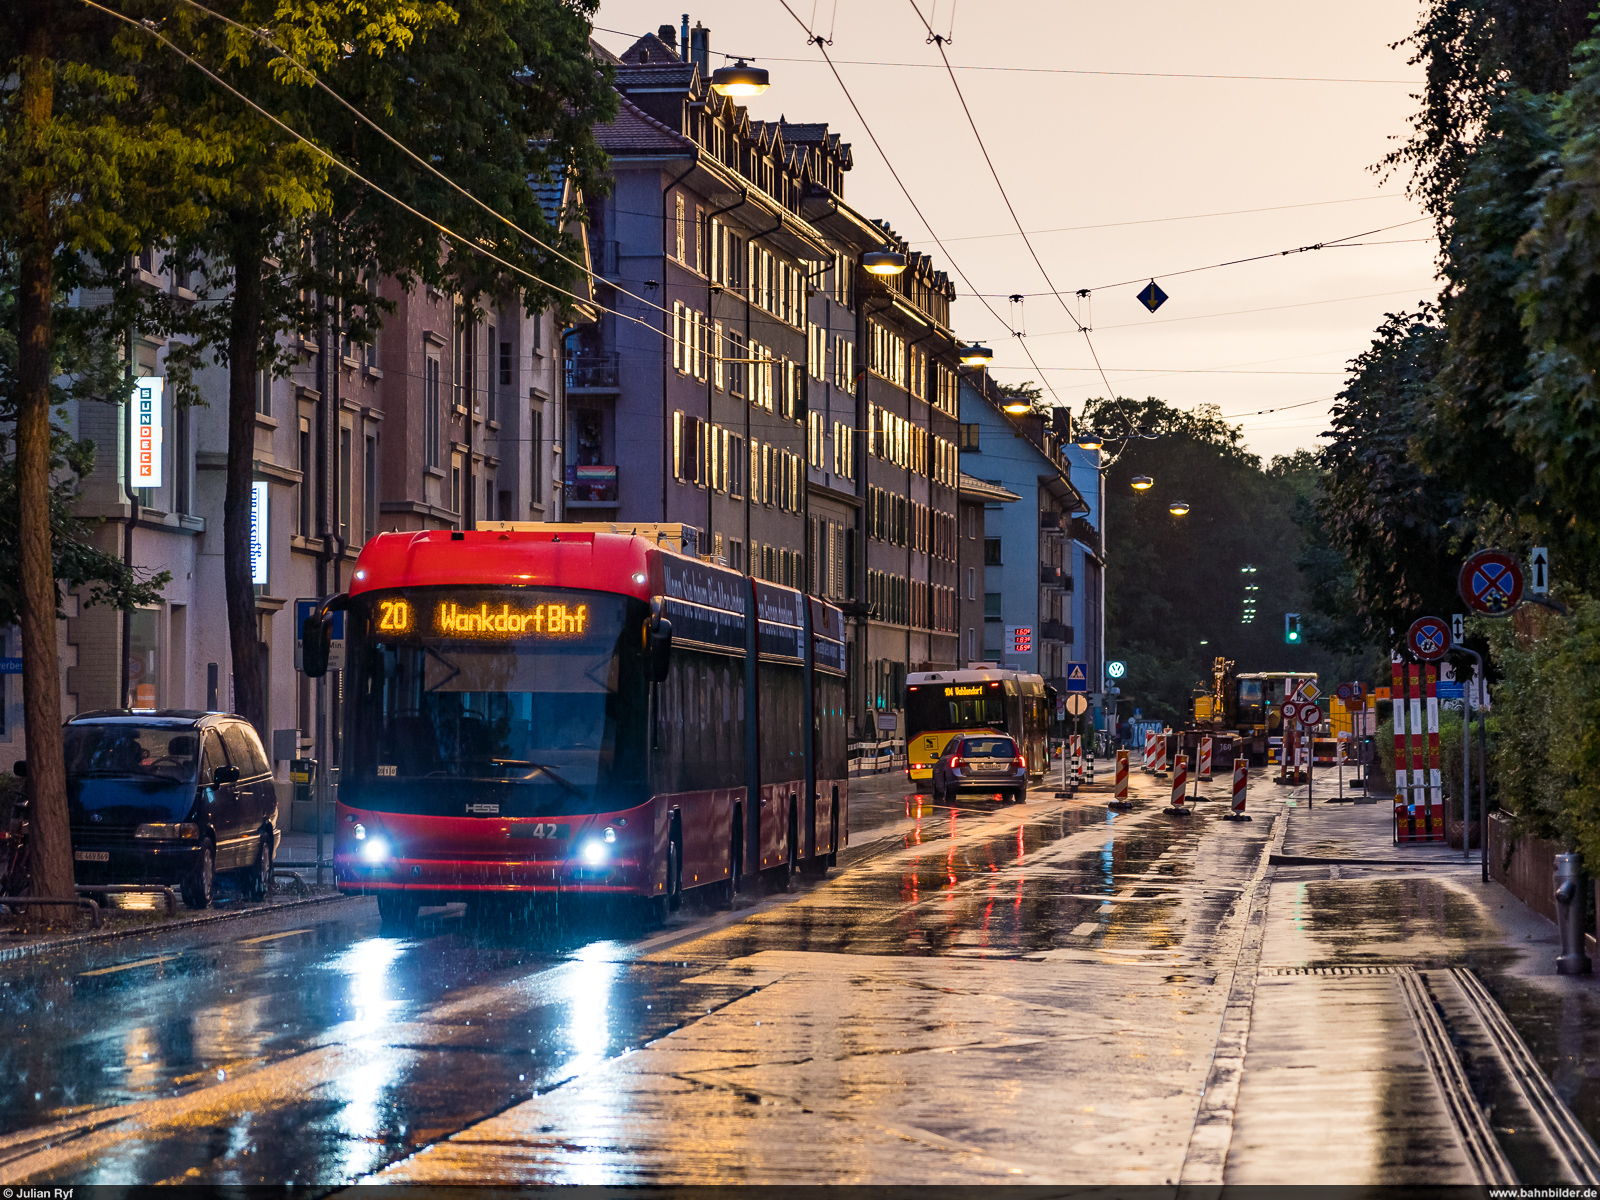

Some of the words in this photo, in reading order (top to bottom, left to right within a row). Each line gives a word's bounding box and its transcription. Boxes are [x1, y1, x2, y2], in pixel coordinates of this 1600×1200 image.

[140, 388, 151, 476] SUNDECK
[380, 601, 407, 630] 20
[441, 603, 545, 632] Wankdorf
[548, 604, 586, 632] Bhf
[1285, 706, 1294, 714] 30
[465, 803, 500, 813] HESS
[533, 823, 557, 839] 42
